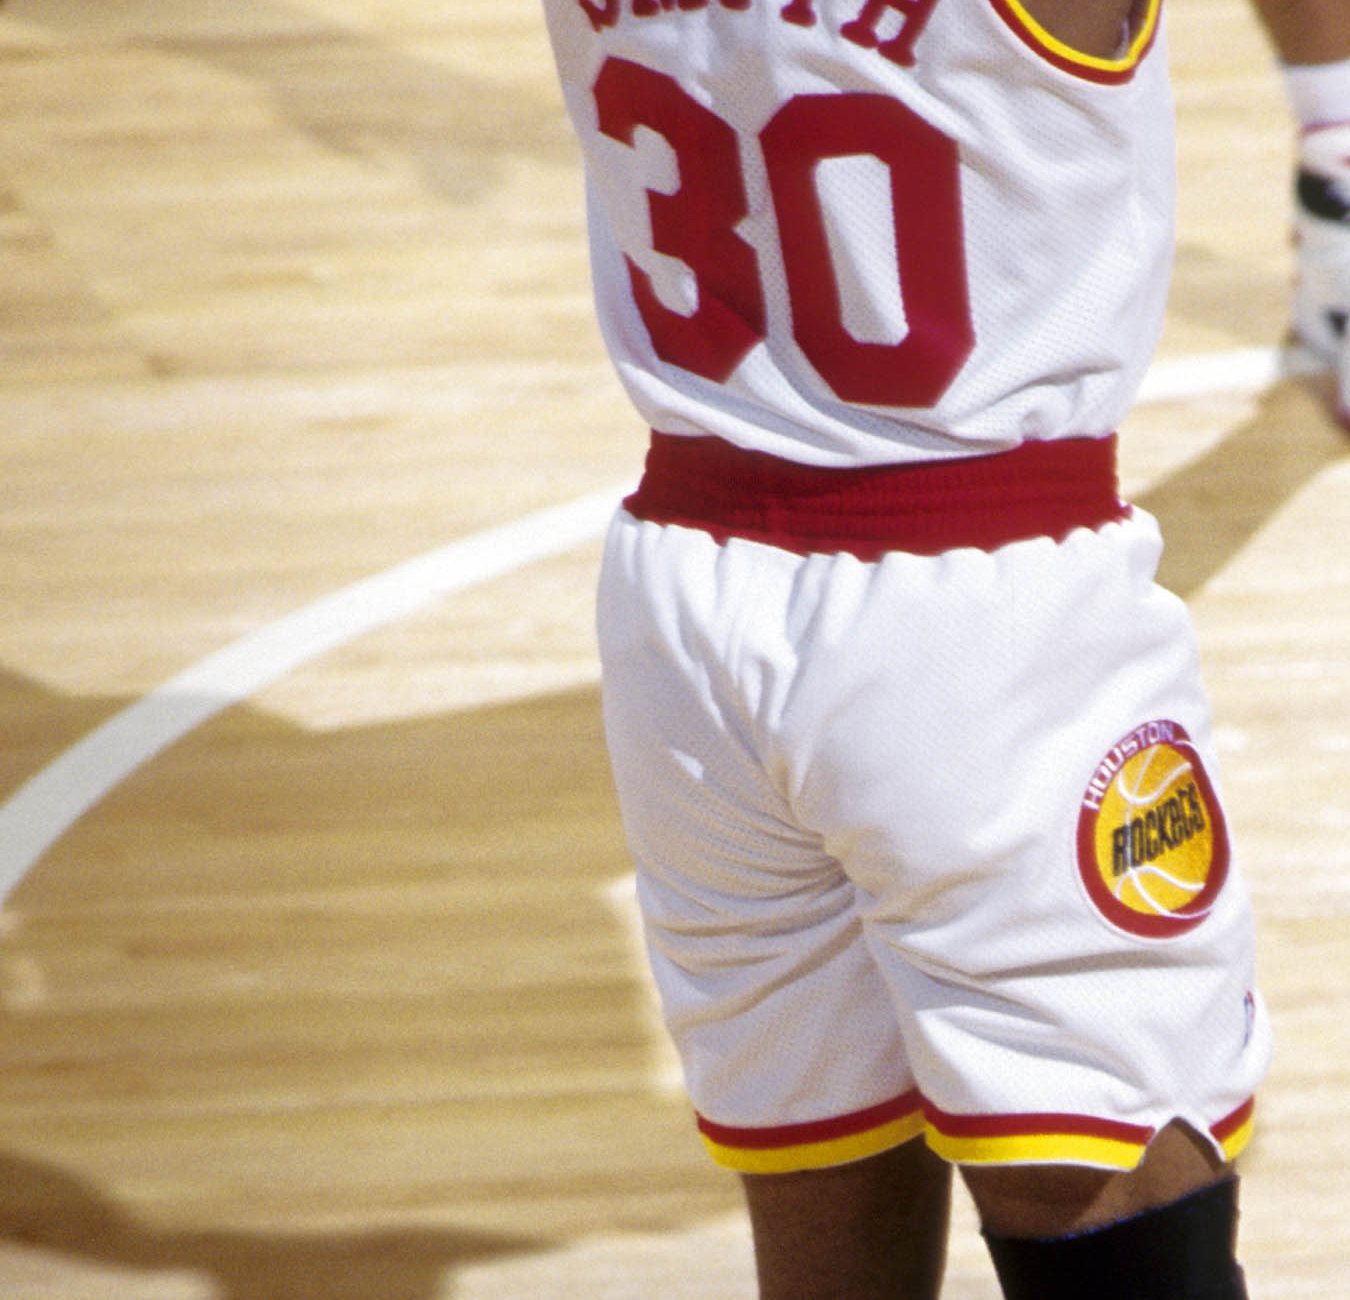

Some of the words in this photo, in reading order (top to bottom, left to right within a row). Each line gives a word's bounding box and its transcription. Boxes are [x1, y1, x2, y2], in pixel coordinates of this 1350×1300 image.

[593, 56, 977, 408] 30
[1083, 722, 1176, 810] HOUSTON
[1111, 783, 1205, 877] ROCKETS
